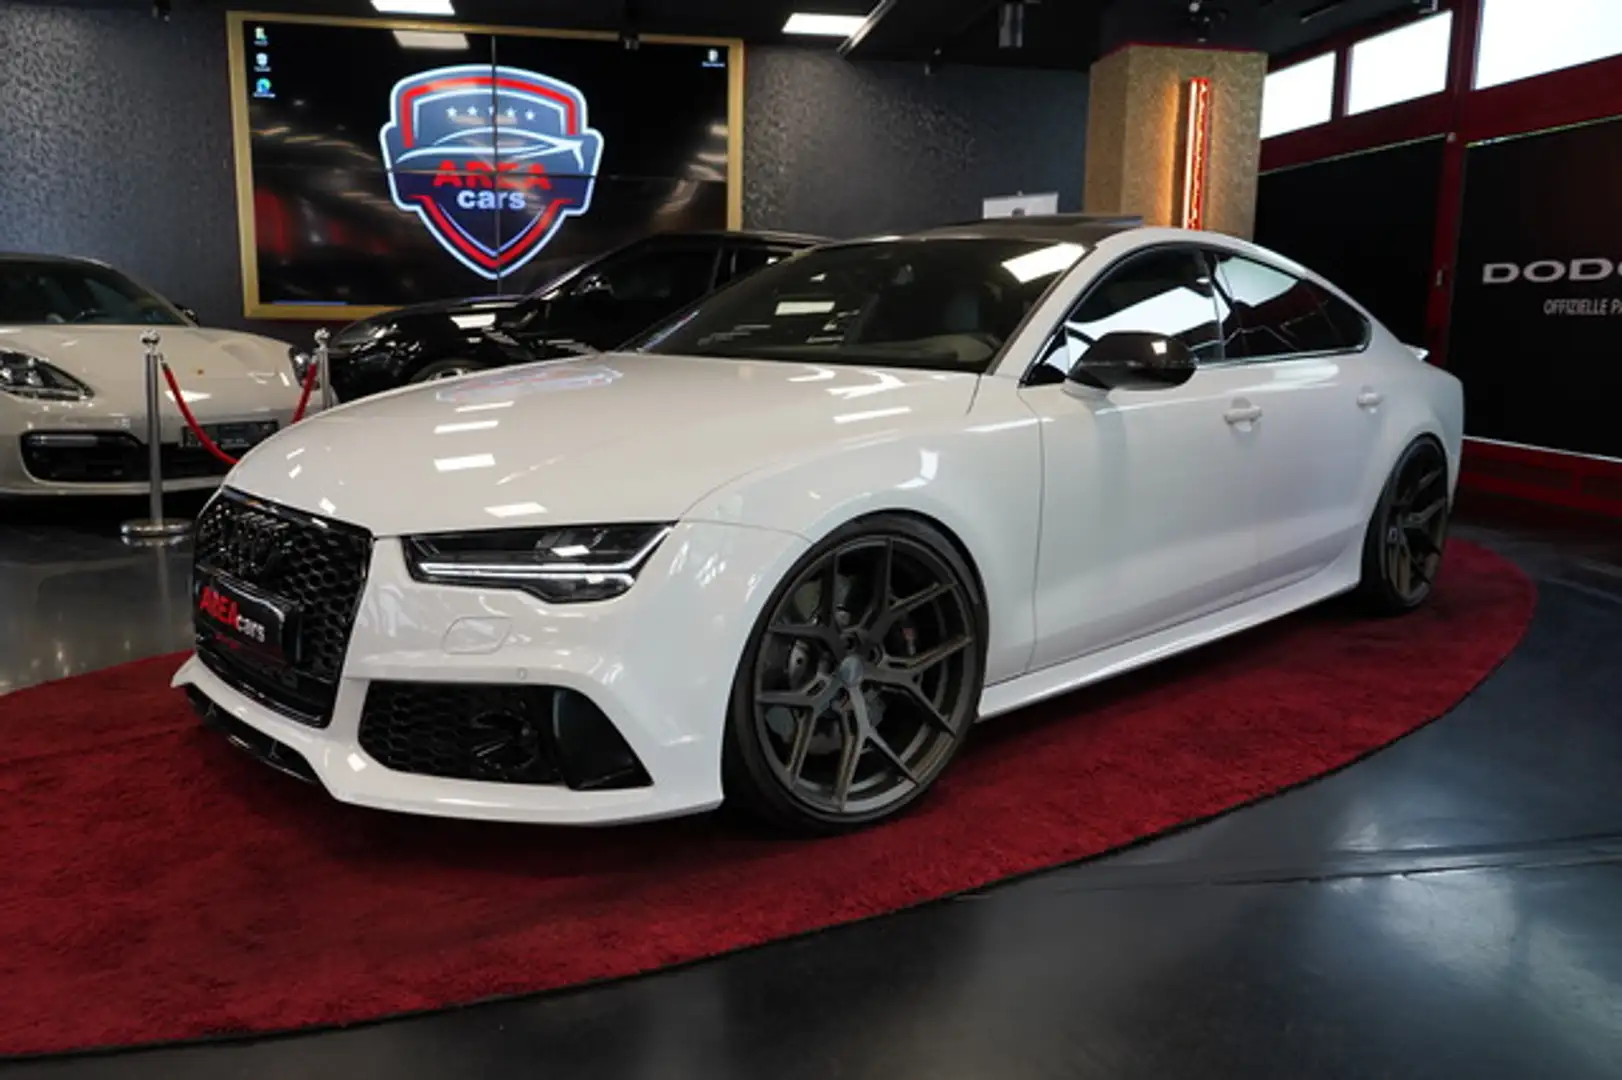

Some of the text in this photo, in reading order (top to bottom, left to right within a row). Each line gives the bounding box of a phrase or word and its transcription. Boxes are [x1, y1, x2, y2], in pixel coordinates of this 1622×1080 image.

[433, 160, 551, 190] AREA
[456, 190, 526, 209] cars
[1483, 259, 1622, 283] DOD
[1543, 298, 1608, 316] OFFIZIELLE
